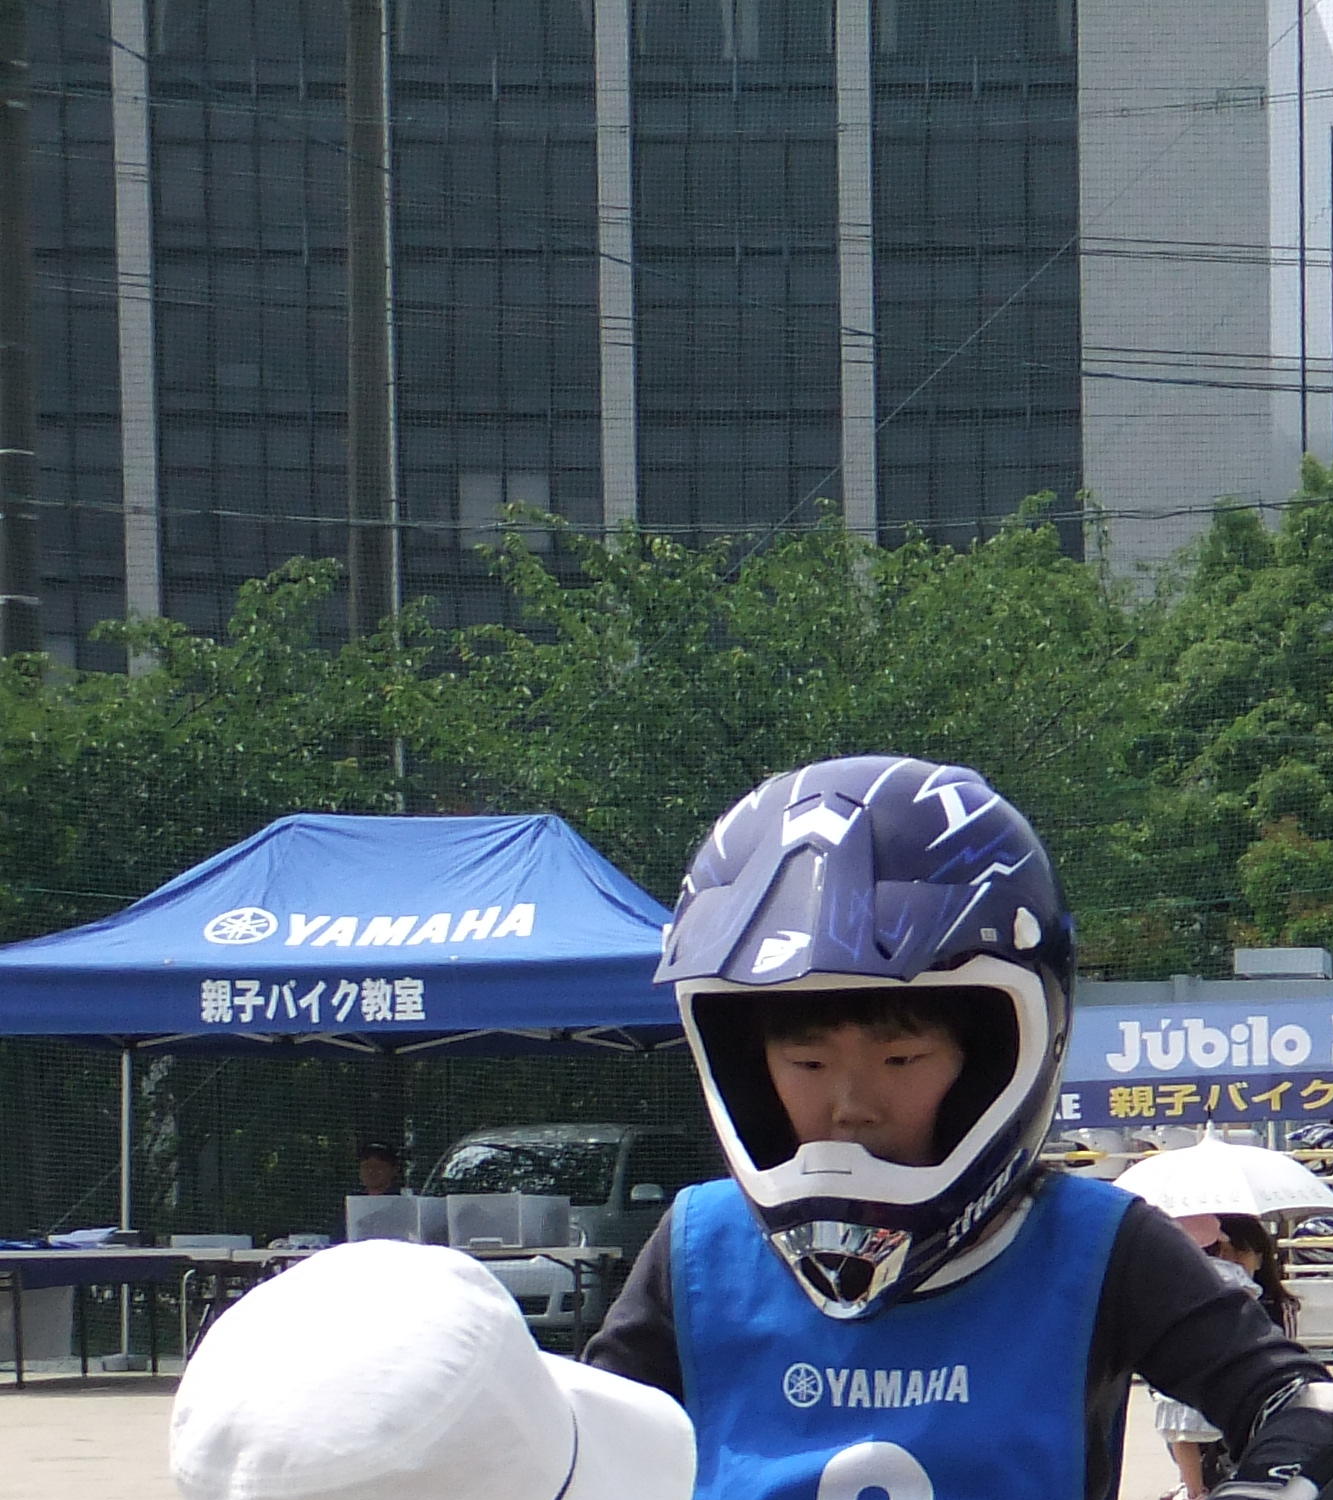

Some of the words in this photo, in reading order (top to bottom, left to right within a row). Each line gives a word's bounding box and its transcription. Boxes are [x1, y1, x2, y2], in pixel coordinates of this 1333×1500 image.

[284, 902, 537, 947] YAMAHA
[200, 977, 427, 1024] 親子バイク教室
[1105, 1015, 1313, 1073] Júbilo
[1055, 1092, 1083, 1120] E
[825, 1364, 970, 1409] YAMAHA
